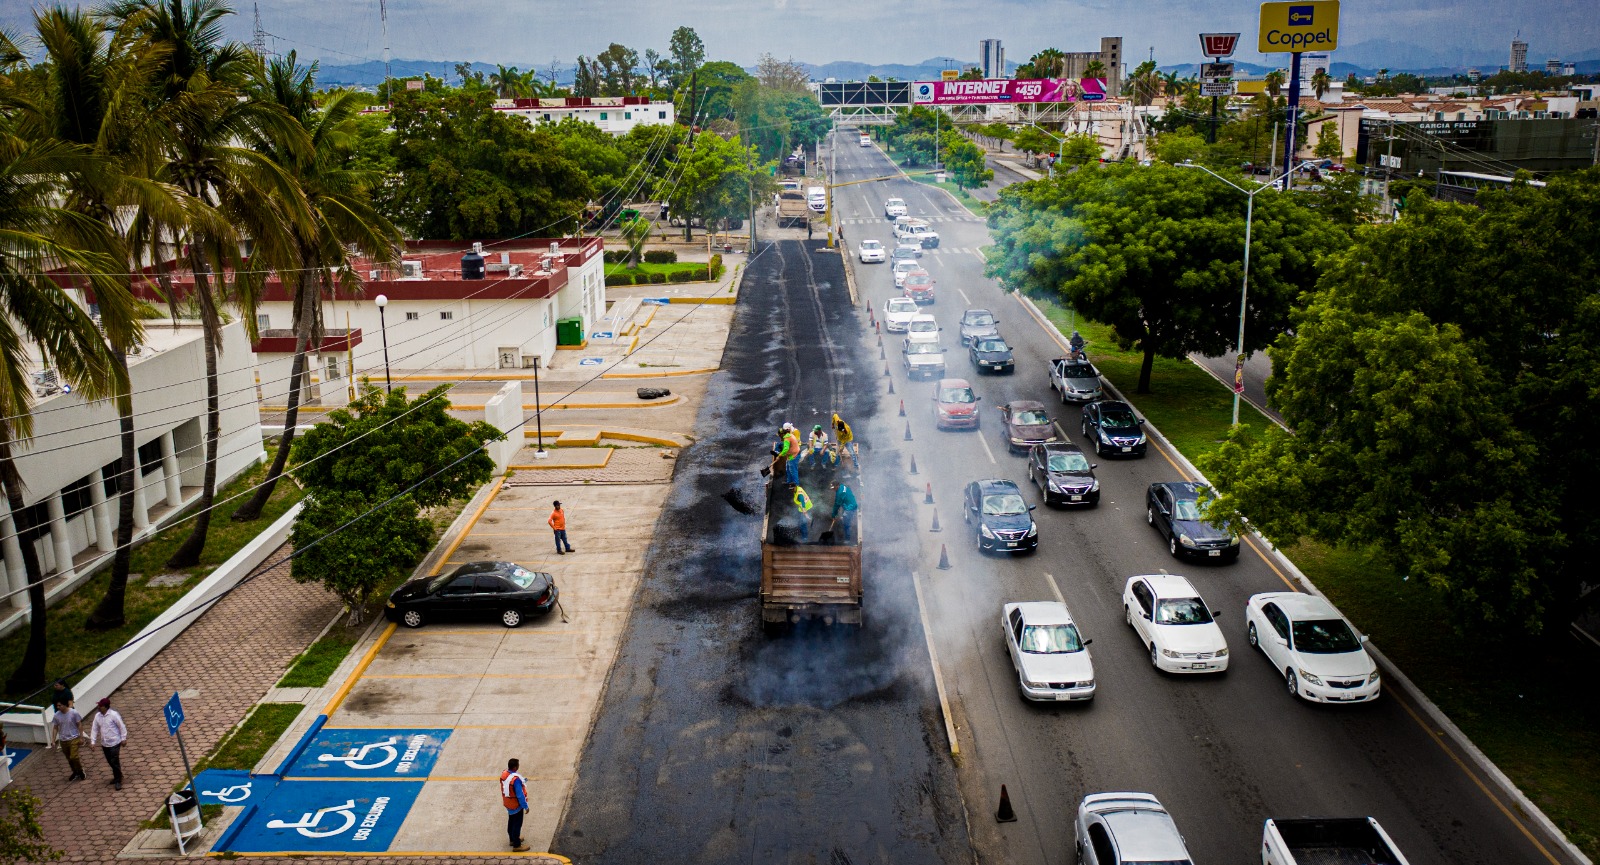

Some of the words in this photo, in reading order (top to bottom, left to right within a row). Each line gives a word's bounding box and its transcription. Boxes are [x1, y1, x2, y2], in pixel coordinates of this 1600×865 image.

[1205, 36, 1236, 55] Ley
[1267, 28, 1332, 48] Coppel
[943, 81, 1010, 95] INTERNET
[1015, 85, 1042, 96] $450
[401, 734, 428, 761] EXCLUSIVO
[360, 796, 390, 828] EXCLUSIVO
[352, 828, 372, 840] USO
